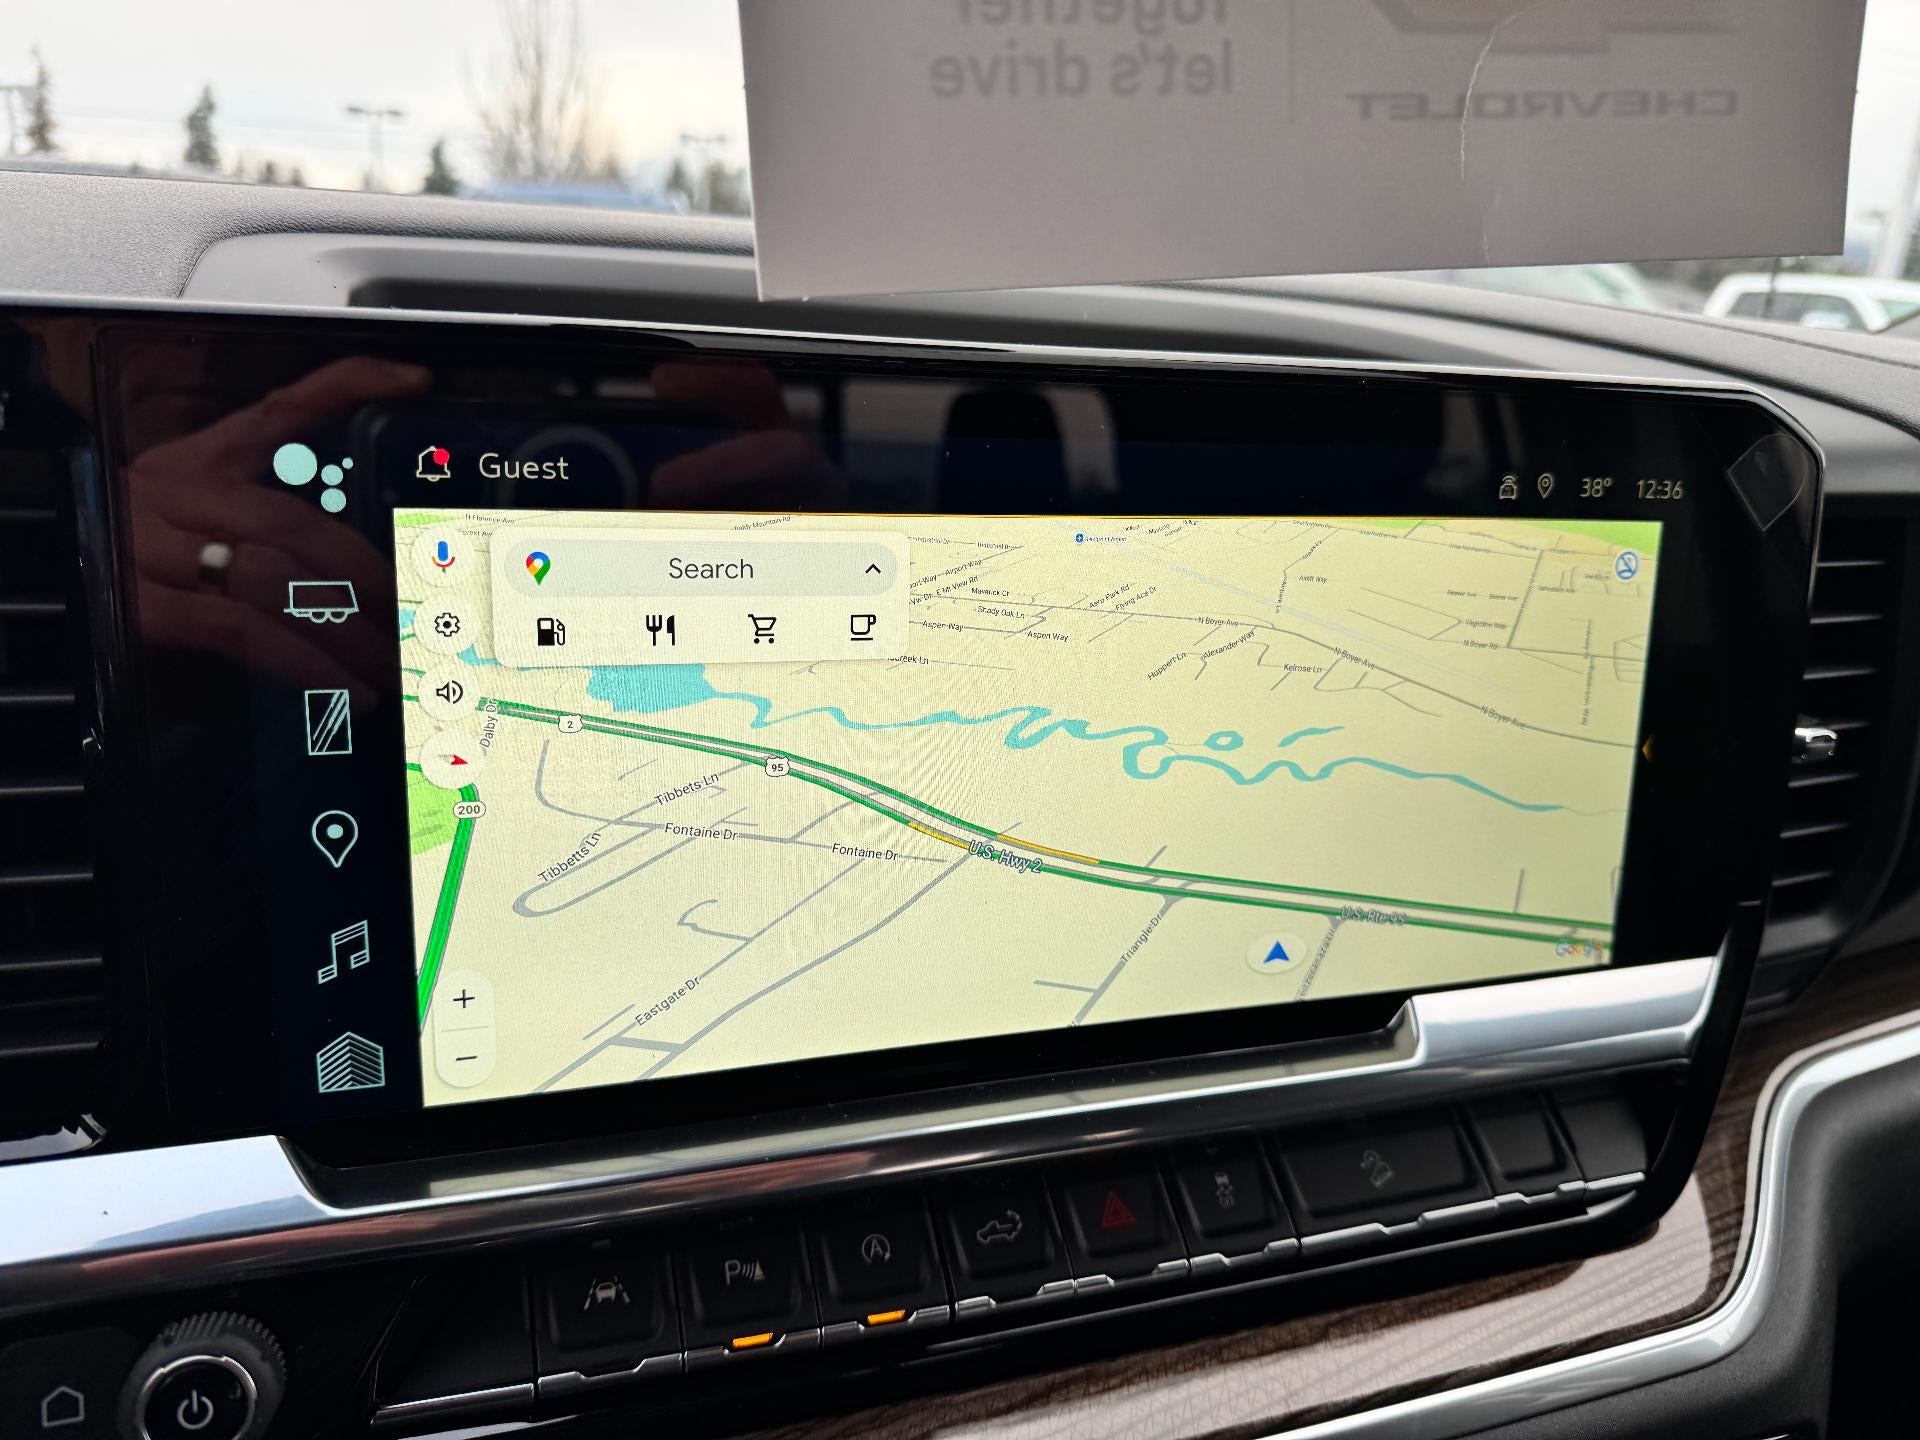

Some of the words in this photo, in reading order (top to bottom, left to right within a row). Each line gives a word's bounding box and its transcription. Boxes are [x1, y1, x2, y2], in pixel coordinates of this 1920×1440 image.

[478, 453, 570, 480] Guest
[1636, 479, 1685, 499] 12:36
[668, 556, 755, 580] Search
[1026, 630, 1051, 640] Aspen
[1051, 633, 1069, 643] Way
[1202, 639, 1240, 660] Alexander
[1239, 629, 1255, 644] Way
[1147, 656, 1177, 681] Huppert
[1176, 651, 1187, 661] Ln
[1341, 649, 1361, 664] Boyer
[1312, 664, 1323, 674] Ln
[484, 698, 499, 713] Dr
[479, 714, 499, 748] Dalby
[567, 721, 574, 730] 2
[771, 762, 785, 773] 95
[655, 779, 702, 806] Tibbets
[701, 771, 719, 786] Ln
[457, 803, 481, 815] 200
[664, 822, 720, 840] Fontaine
[723, 828, 738, 841] Dr
[538, 845, 591, 882] Tibbetts
[584, 831, 602, 849] Ln
[831, 843, 882, 859] Fontaine
[884, 849, 899, 861] Dr
[967, 838, 997, 861] U.S.
[998, 848, 1032, 875] Hwy
[1031, 858, 1044, 874] 2
[1119, 926, 1153, 963] Triangle
[1149, 913, 1163, 928] Dr
[635, 986, 687, 1027] Eastgate
[684, 976, 700, 991] Dr
